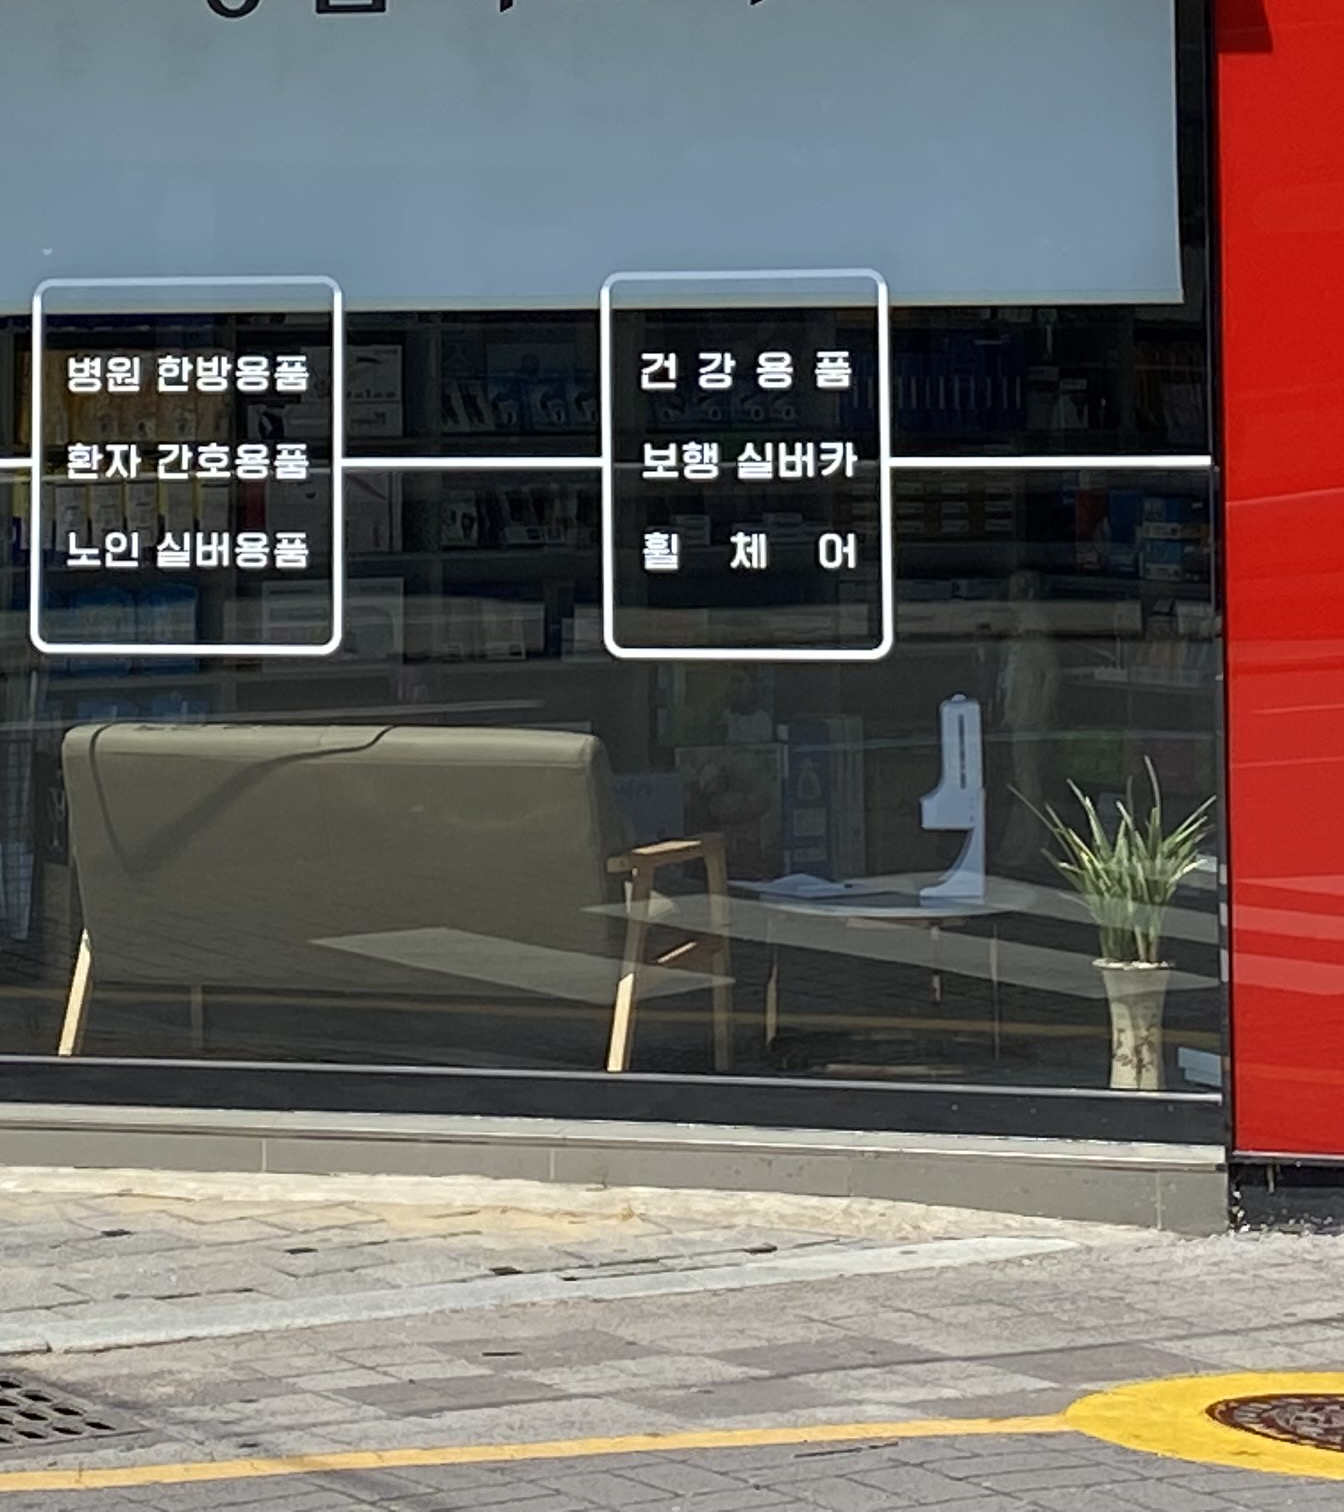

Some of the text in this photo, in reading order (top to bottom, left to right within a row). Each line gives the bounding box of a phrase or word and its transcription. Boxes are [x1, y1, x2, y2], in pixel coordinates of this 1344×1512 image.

[66, 354, 310, 393] 병원 한방용품
[66, 442, 310, 481] 환자 간호용품
[641, 440, 859, 480] 보행 실버카
[66, 530, 310, 570] 노인 실버용품
